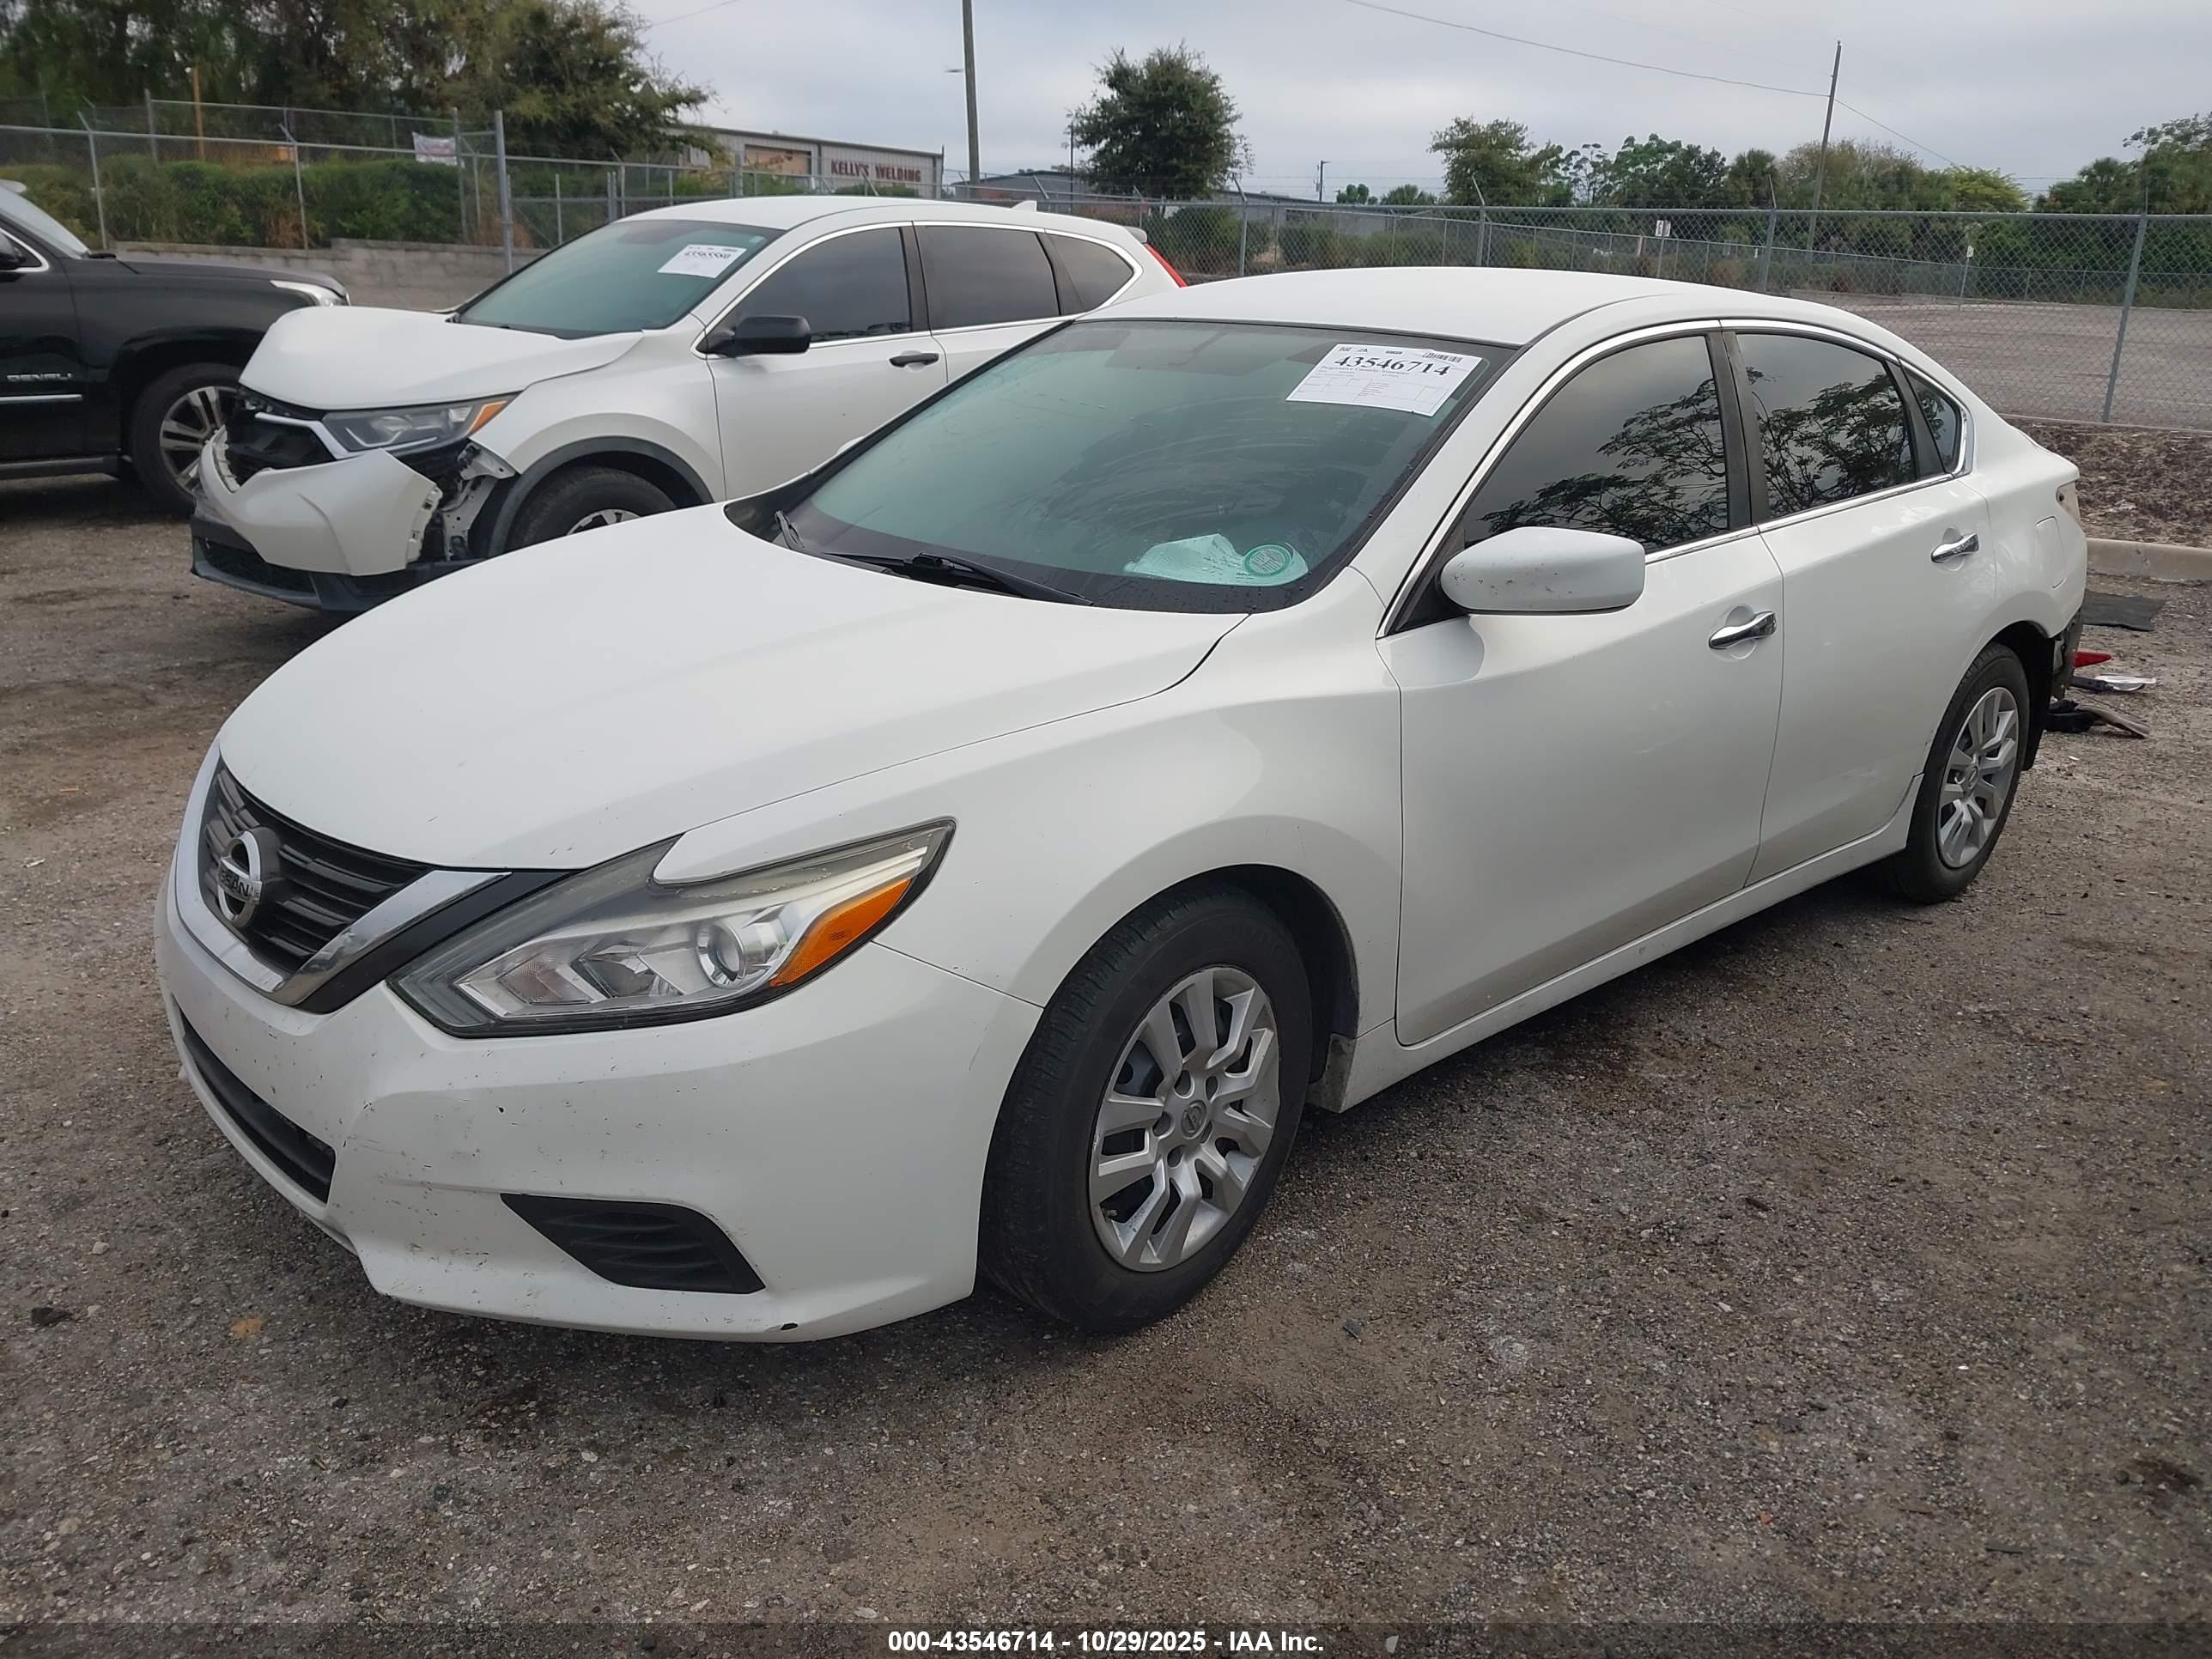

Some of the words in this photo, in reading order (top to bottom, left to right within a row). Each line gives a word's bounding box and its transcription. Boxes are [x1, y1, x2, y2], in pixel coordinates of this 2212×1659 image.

[831, 160, 869, 177] KELLY'S
[875, 164, 921, 182] WELDING
[1334, 356, 1450, 376] 43546714
[7, 373, 71, 383] DENALI
